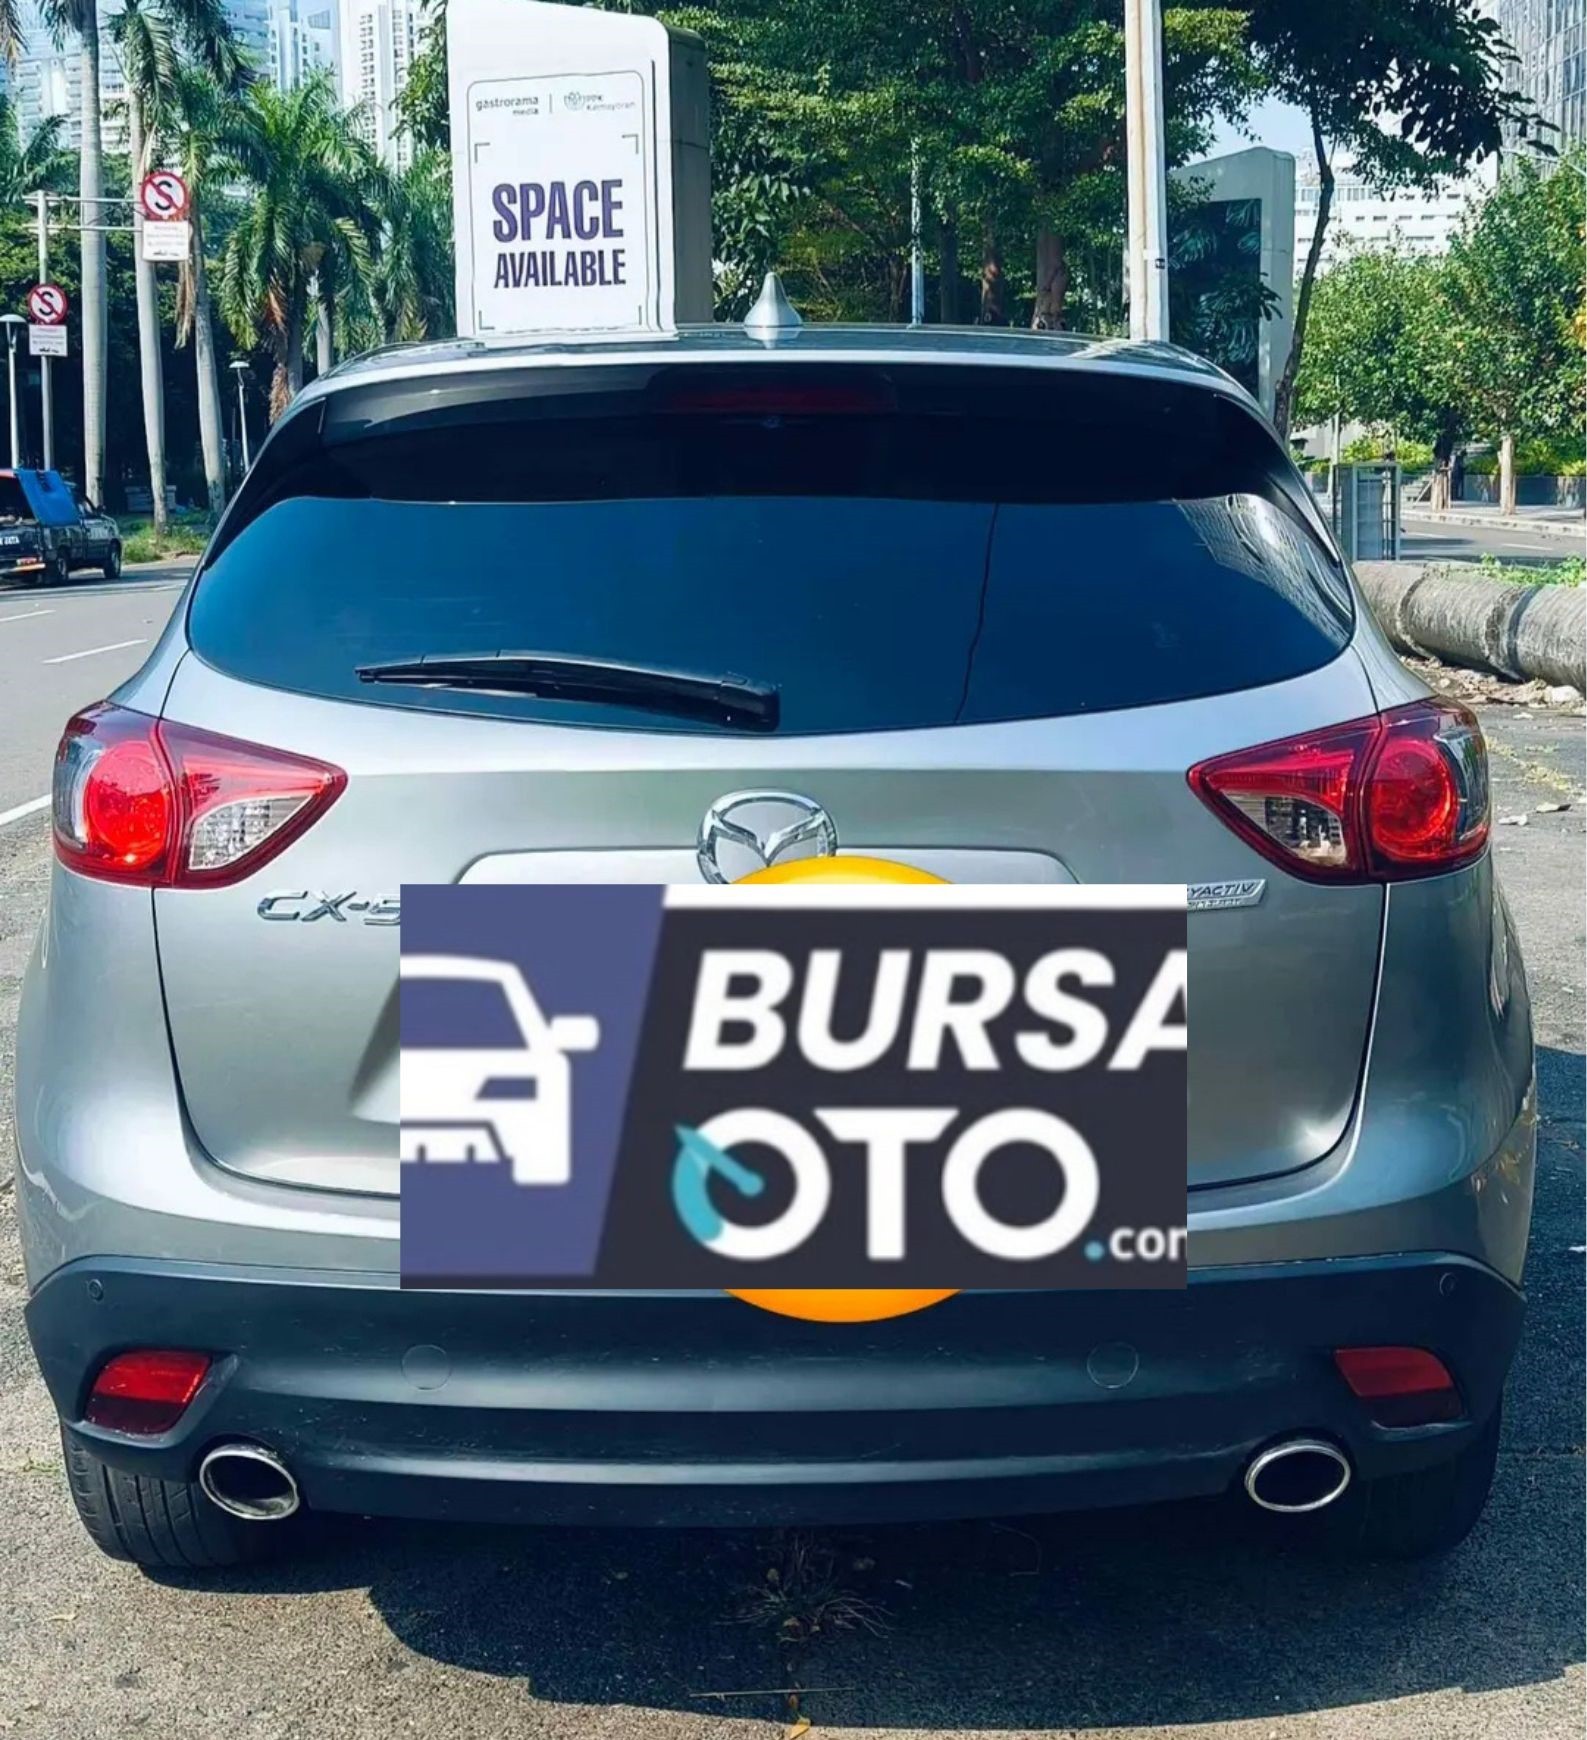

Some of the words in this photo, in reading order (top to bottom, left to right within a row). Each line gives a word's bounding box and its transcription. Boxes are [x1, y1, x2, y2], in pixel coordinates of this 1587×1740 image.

[475, 96, 539, 112] gastrorama
[492, 179, 624, 243] SPACE
[494, 249, 626, 289] AVAILABLE
[257, 890, 400, 926] CX-5
[1187, 883, 1255, 898] YACTIV
